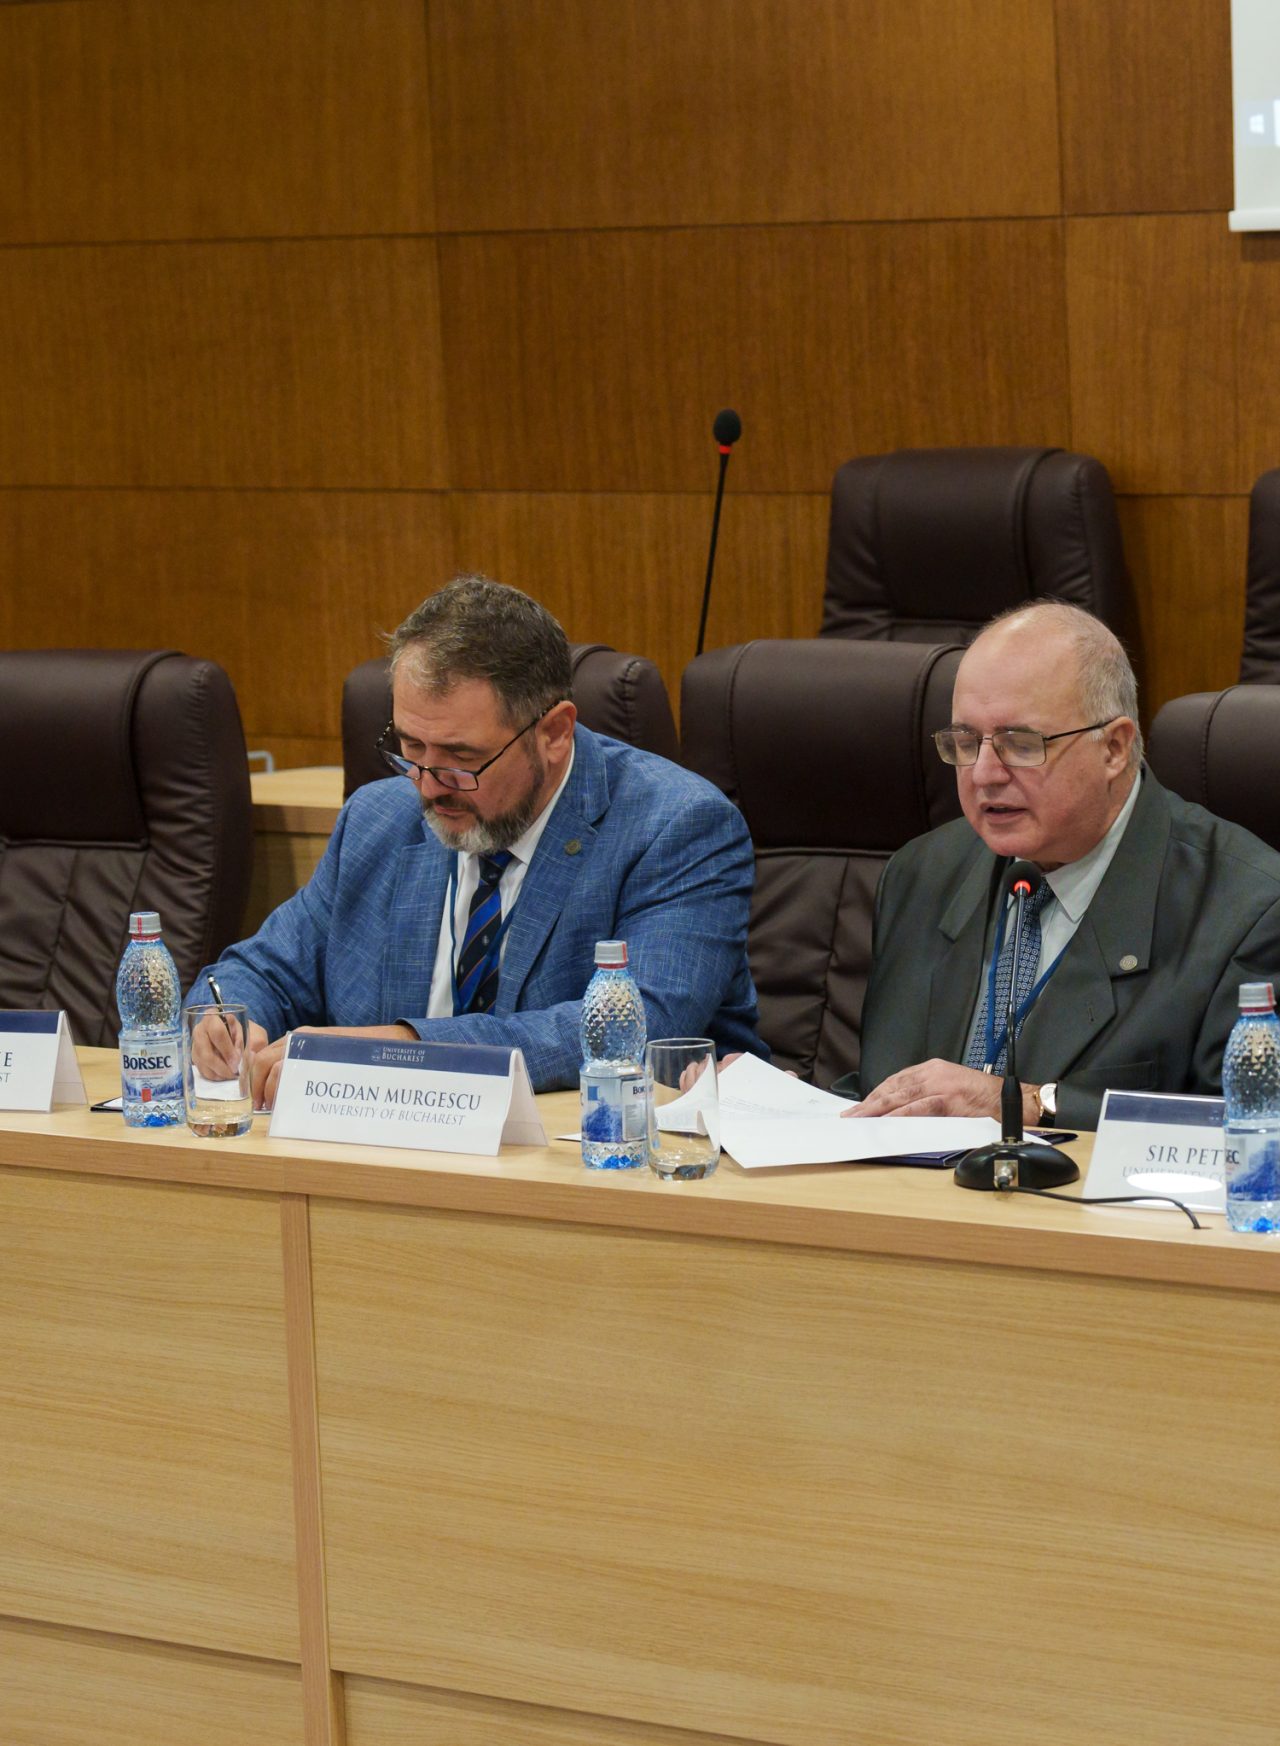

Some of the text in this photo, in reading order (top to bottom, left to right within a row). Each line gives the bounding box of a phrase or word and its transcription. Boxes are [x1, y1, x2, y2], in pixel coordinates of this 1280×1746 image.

[382, 1046, 416, 1055] UNIVERSITY
[382, 1053, 425, 1063] BUCHAREST
[0, 1051, 13, 1067] E
[123, 1054, 172, 1070] BORSEC
[305, 1080, 482, 1111] BOGDAN MURGESCU
[311, 1102, 466, 1126] UNIVERSITY OF BUCHAREST
[1146, 1144, 1225, 1166] SIR PET
